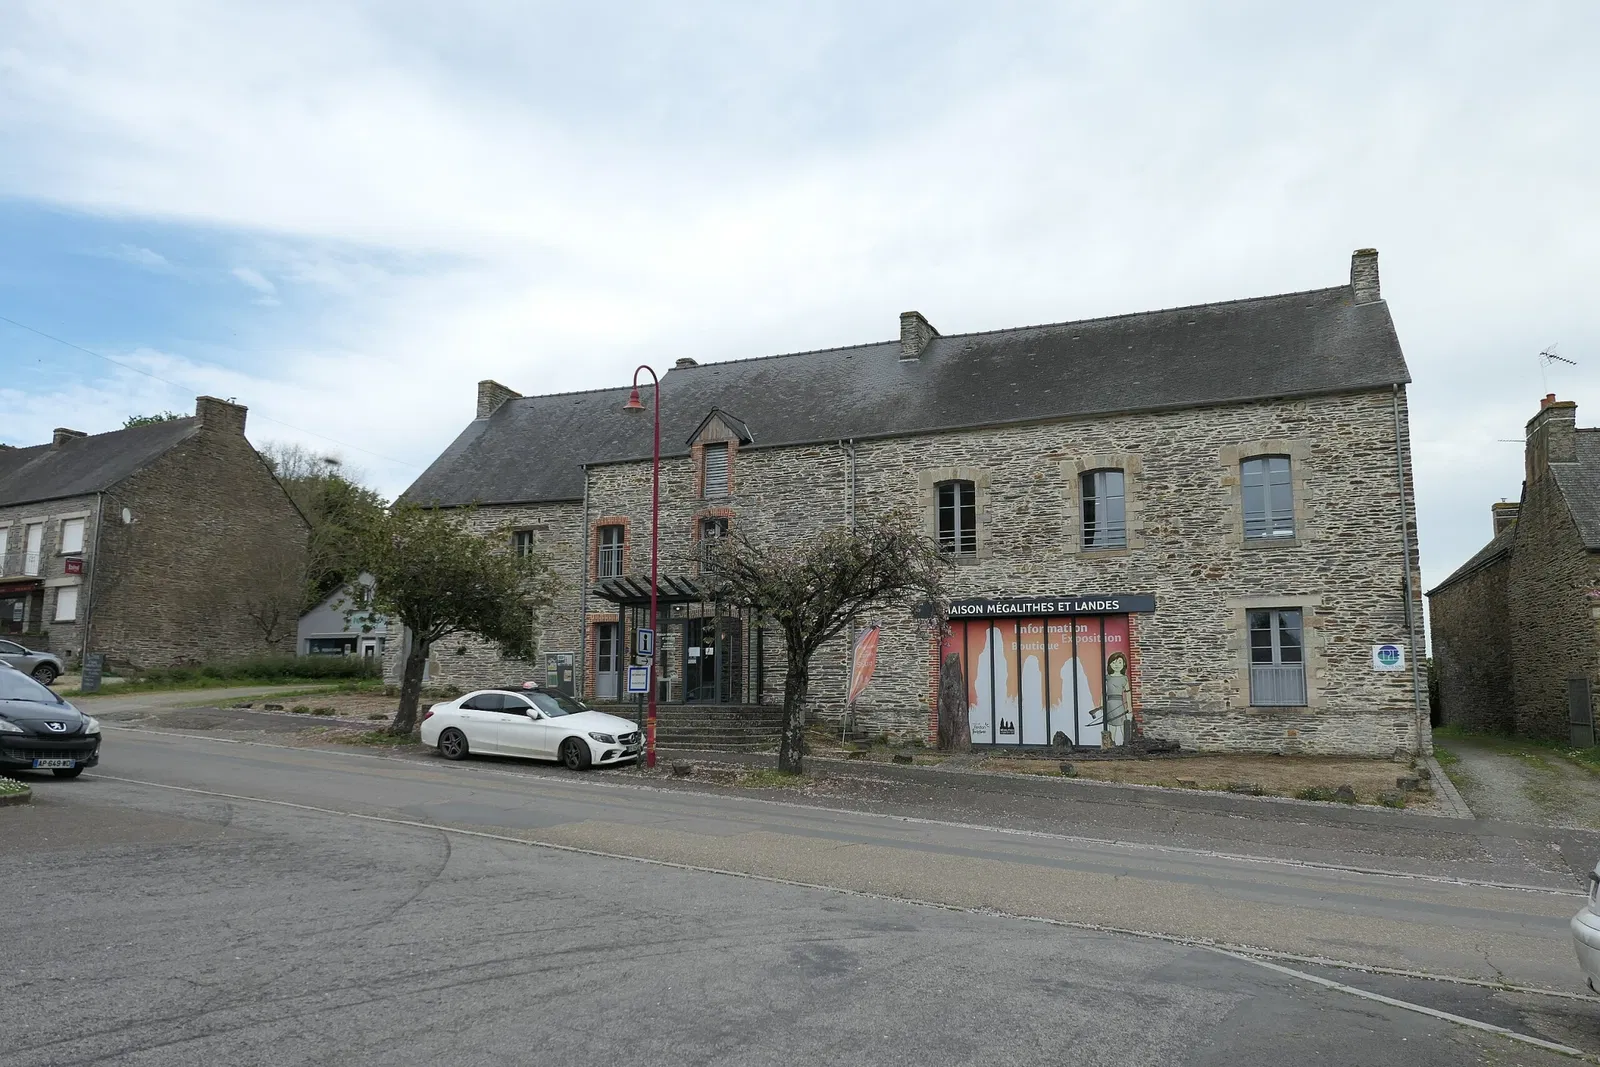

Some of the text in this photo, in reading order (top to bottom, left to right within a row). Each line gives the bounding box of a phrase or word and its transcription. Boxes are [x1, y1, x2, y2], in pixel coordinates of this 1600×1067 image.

[986, 601, 1054, 614] MÉGALITHES
[1058, 602, 1072, 612] ET
[1075, 600, 1120, 611] LANDES
[1014, 622, 1088, 634] Information
[1061, 632, 1122, 646] Exposition
[1011, 641, 1059, 653] Boutique
